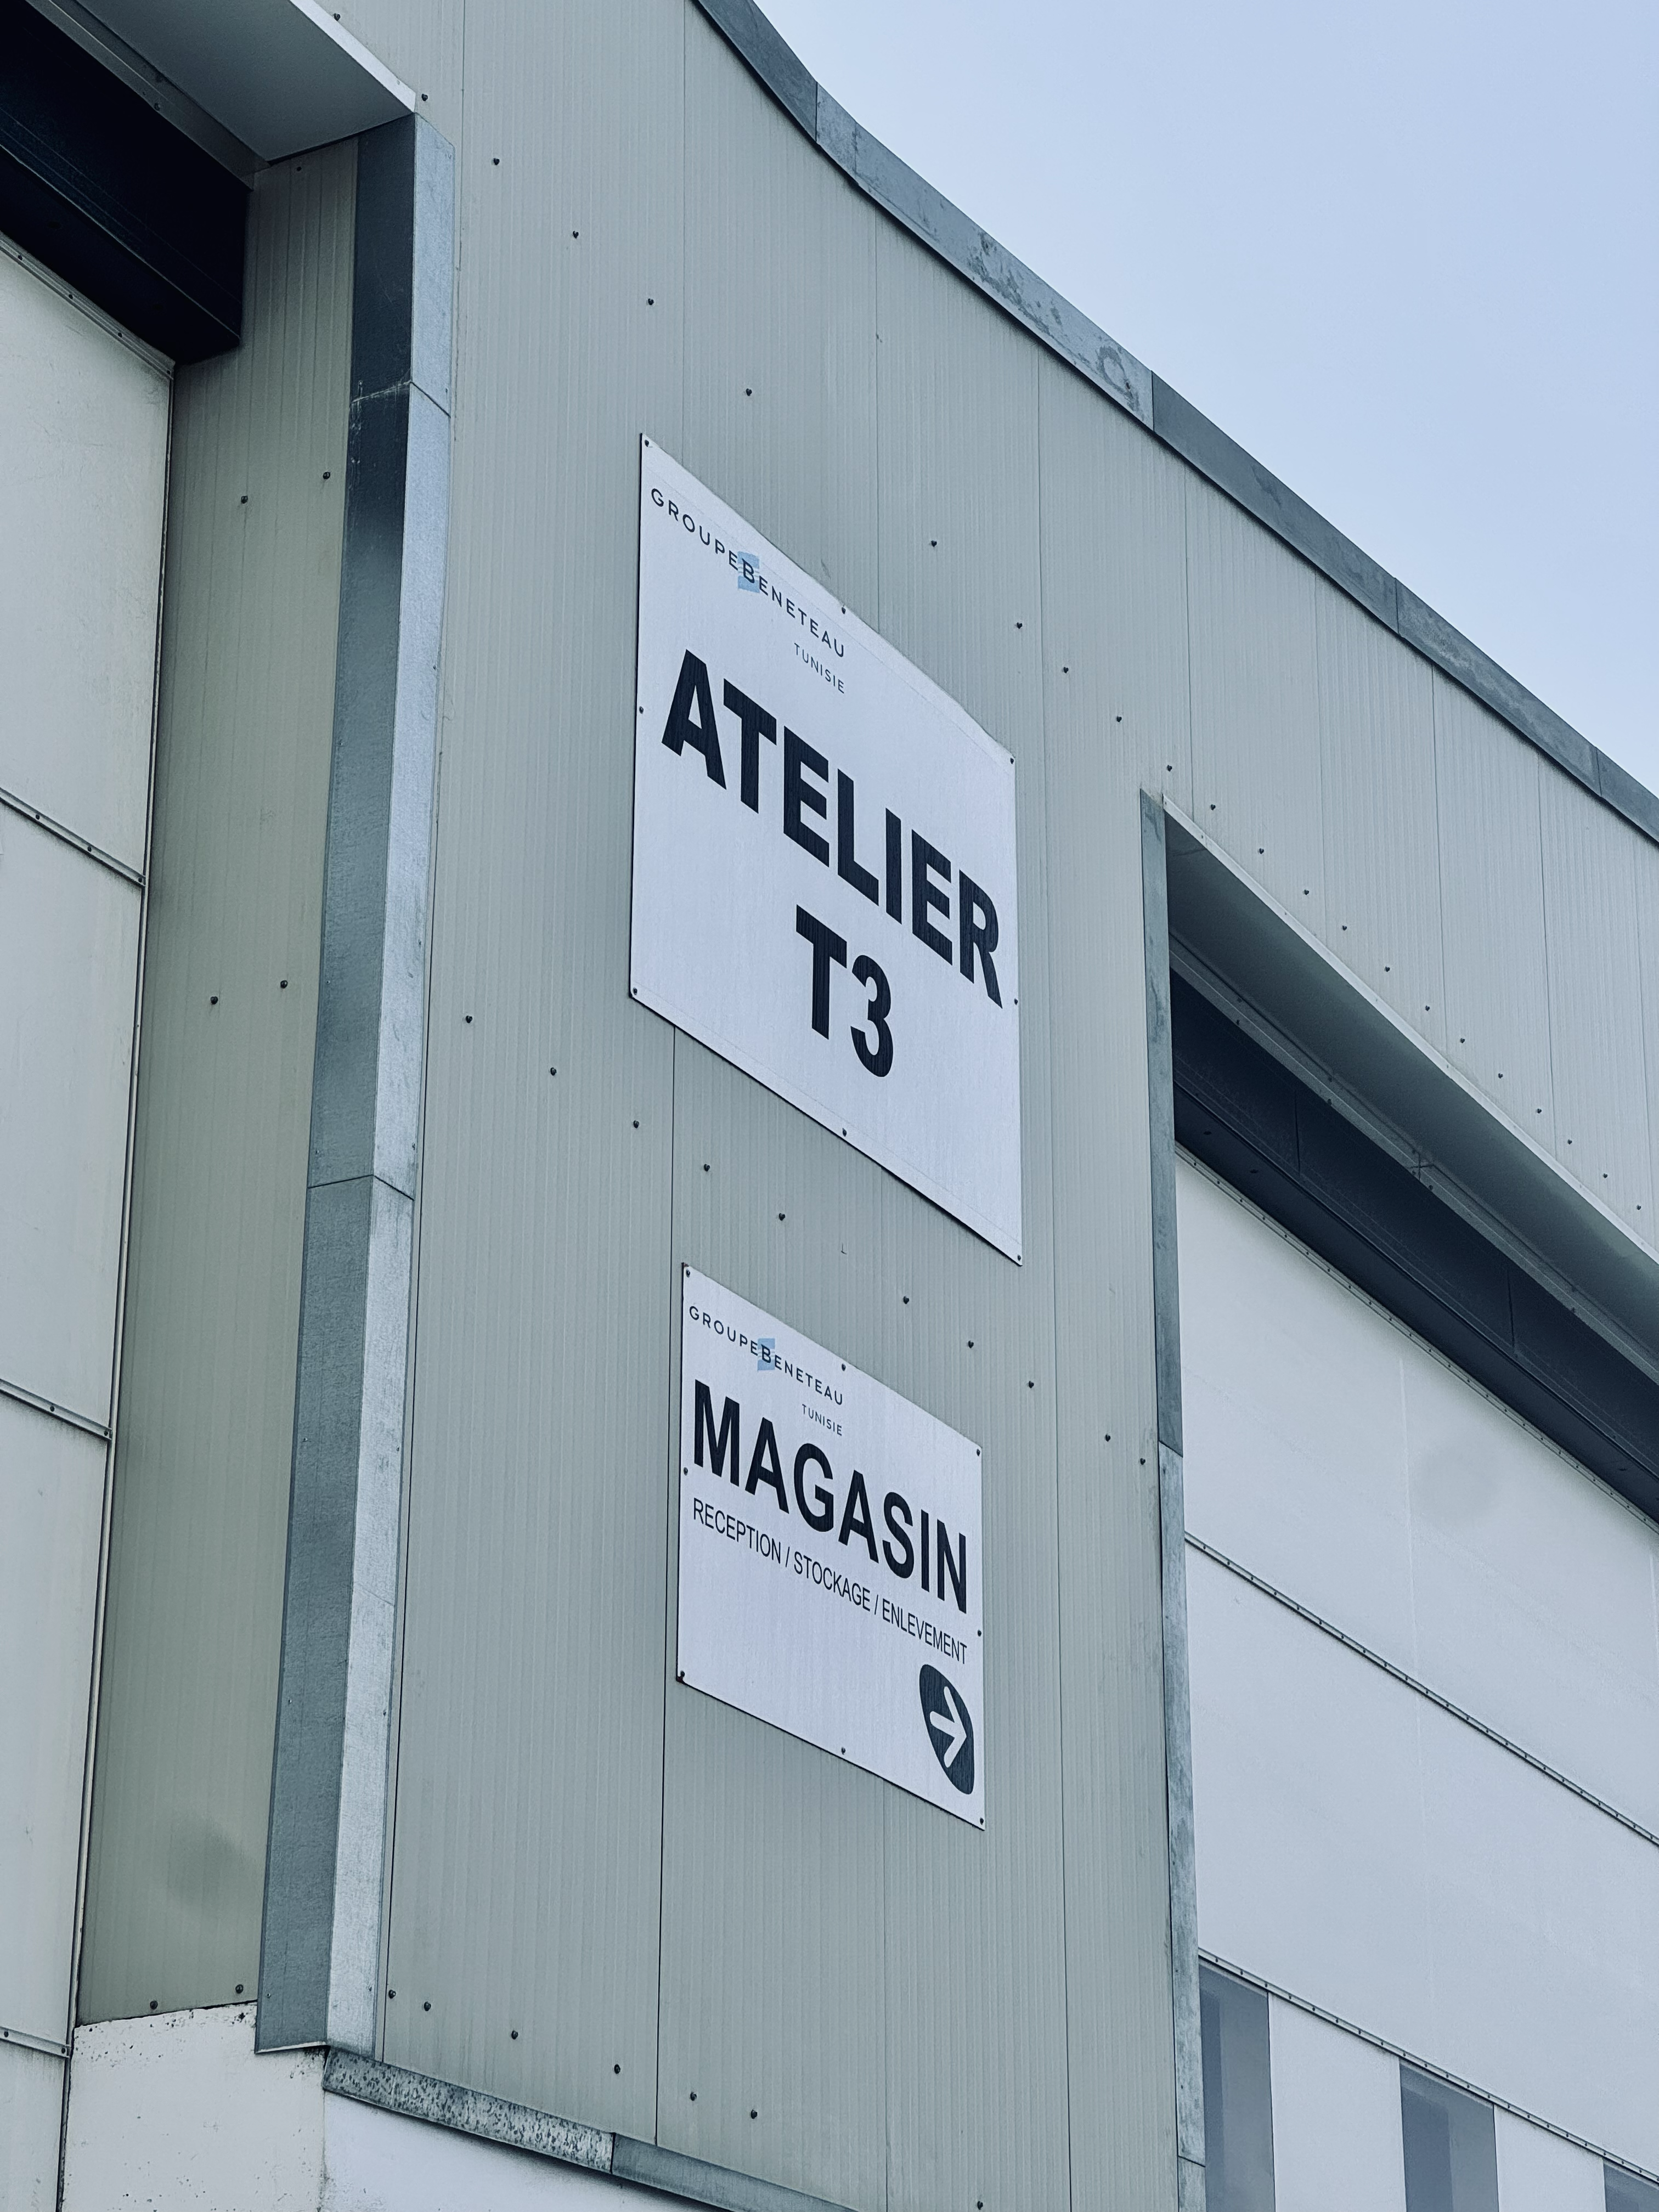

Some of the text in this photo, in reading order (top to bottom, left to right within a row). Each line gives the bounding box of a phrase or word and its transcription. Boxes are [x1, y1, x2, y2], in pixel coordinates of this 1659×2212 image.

[794, 642, 844, 694] TUNISIE
[661, 648, 1003, 1009] ATELIER
[796, 904, 894, 1077] T3
[693, 1379, 967, 1614] MAGASIN
[802, 1403, 842, 1436] TUNISIE
[693, 1497, 781, 1564] RECEPTION
[794, 1551, 871, 1612] STOCKAGE
[882, 1598, 967, 1664] ENLEVEMENT
